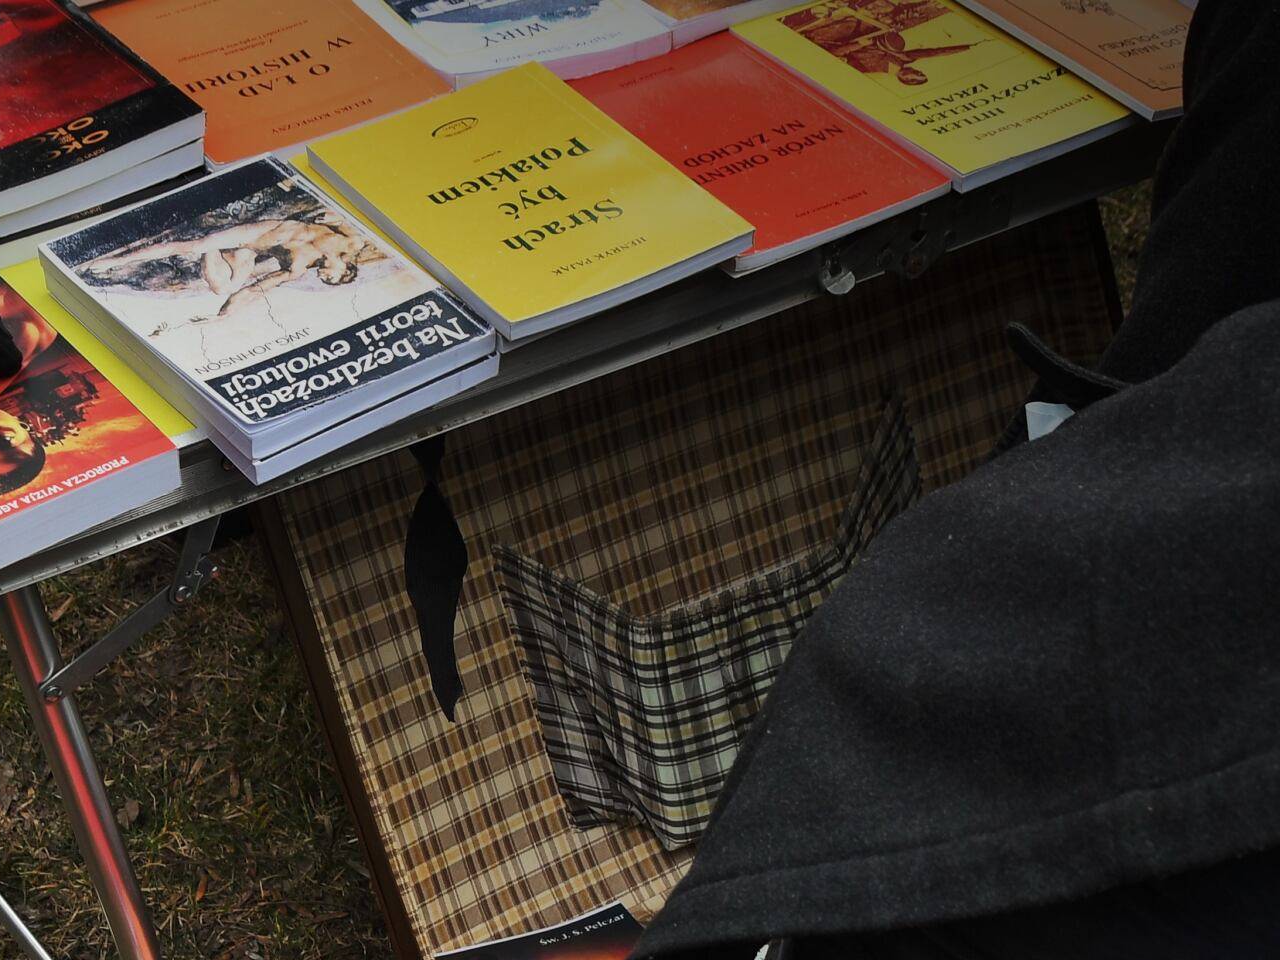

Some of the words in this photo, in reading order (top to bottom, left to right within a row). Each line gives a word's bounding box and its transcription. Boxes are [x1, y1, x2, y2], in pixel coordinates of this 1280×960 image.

[326, 36, 353, 52] W
[484, 22, 549, 47] WIRY
[184, 48, 312, 94] HISTORII
[308, 63, 331, 76] O
[333, 97, 373, 116] FELIKS
[901, 83, 990, 115] IZRAELA
[916, 63, 1071, 125] ZAŁOŻYCIELEM
[772, 119, 806, 136] NA
[935, 107, 1006, 135] HITLER
[683, 132, 771, 168] ZACHÓD
[771, 124, 844, 157] NAPÓR
[426, 137, 595, 206] Polakiem
[498, 184, 568, 220] być
[502, 198, 624, 252] Strach
[595, 236, 648, 262] HENRYK
[356, 300, 443, 346] teorii
[412, 317, 471, 348] Na
[195, 338, 274, 375] JOHNSON
[221, 338, 352, 397] ewolucji
[234, 337, 420, 419] bezdrożach
[61, 455, 128, 489] PROROCZA
[18, 481, 62, 507] WIZJA
[561, 931, 571, 940] J.
[572, 927, 583, 937] S.
[584, 912, 625, 933] Pelczar
